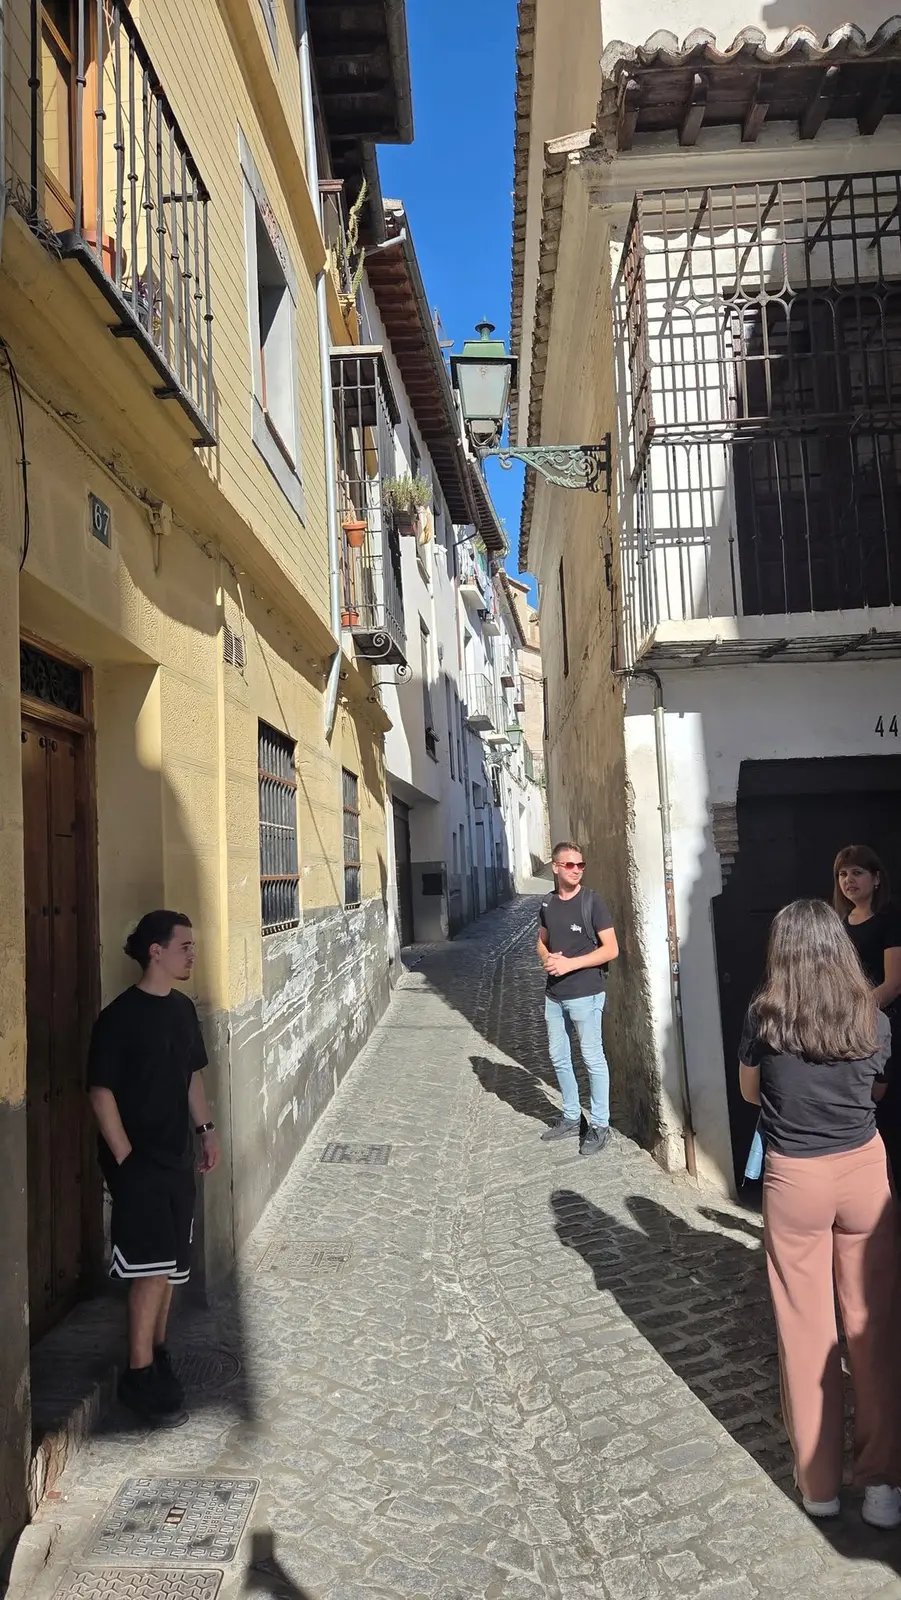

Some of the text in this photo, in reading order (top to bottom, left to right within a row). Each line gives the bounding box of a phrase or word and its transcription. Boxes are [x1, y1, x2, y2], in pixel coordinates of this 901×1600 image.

[95, 503, 110, 536] 67
[874, 714, 899, 738] 44
[195, 1497, 219, 1540] ALUMBRADO
